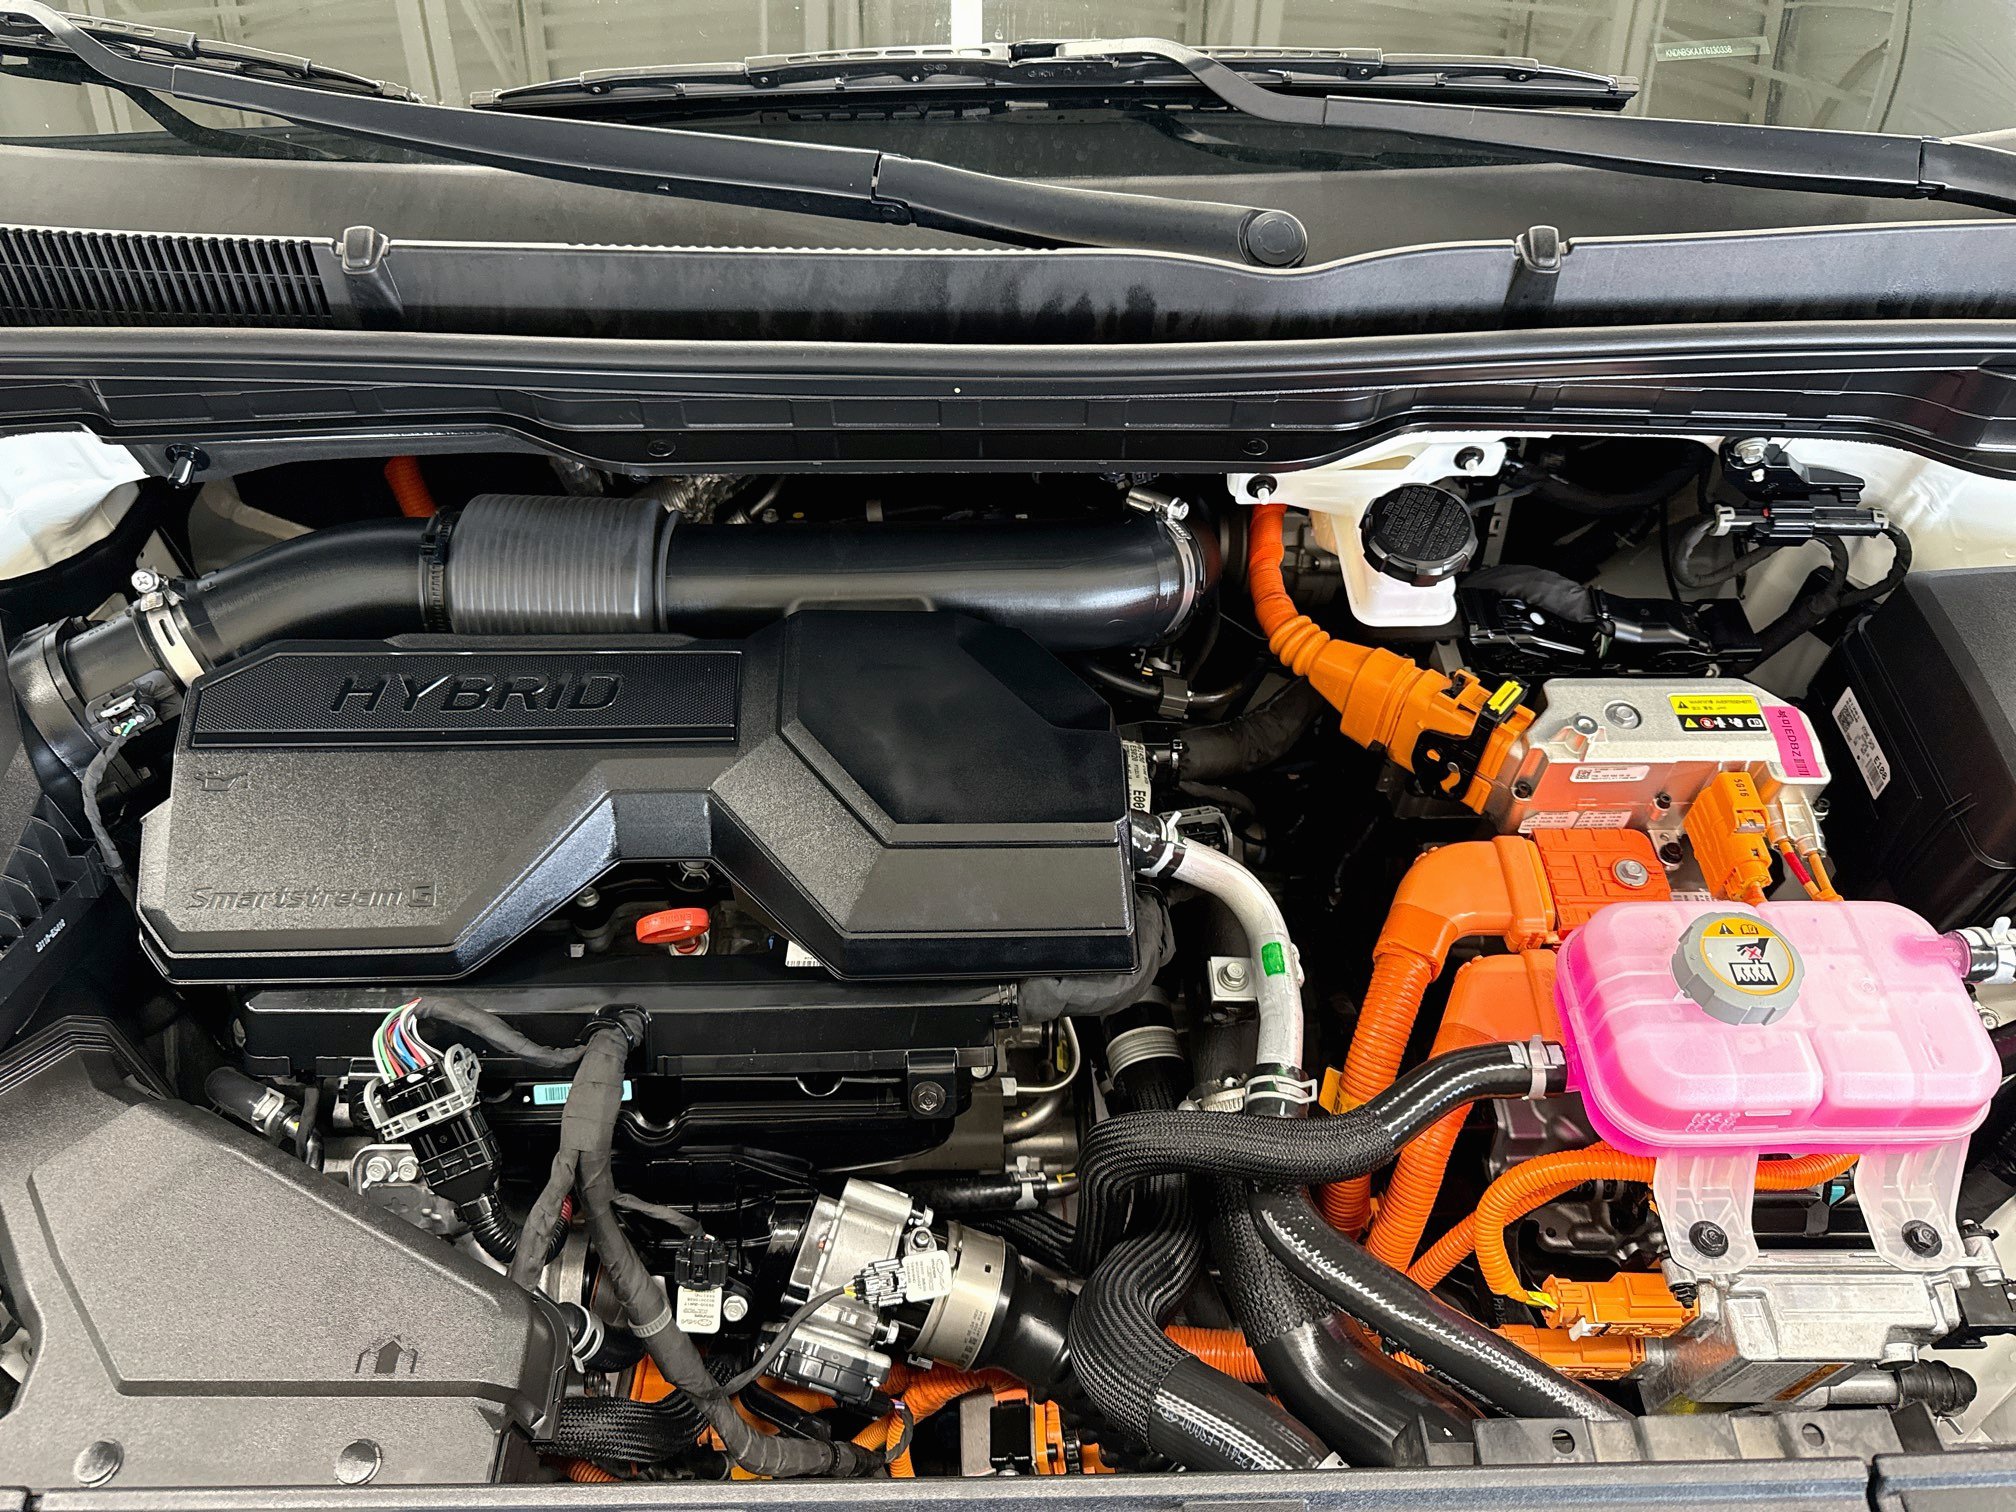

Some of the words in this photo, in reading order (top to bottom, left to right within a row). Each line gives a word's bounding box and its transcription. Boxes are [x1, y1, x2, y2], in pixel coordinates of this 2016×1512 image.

[329, 672, 626, 714] HYBRID
[186, 884, 403, 911] Smartstream
[410, 884, 436, 906] G
